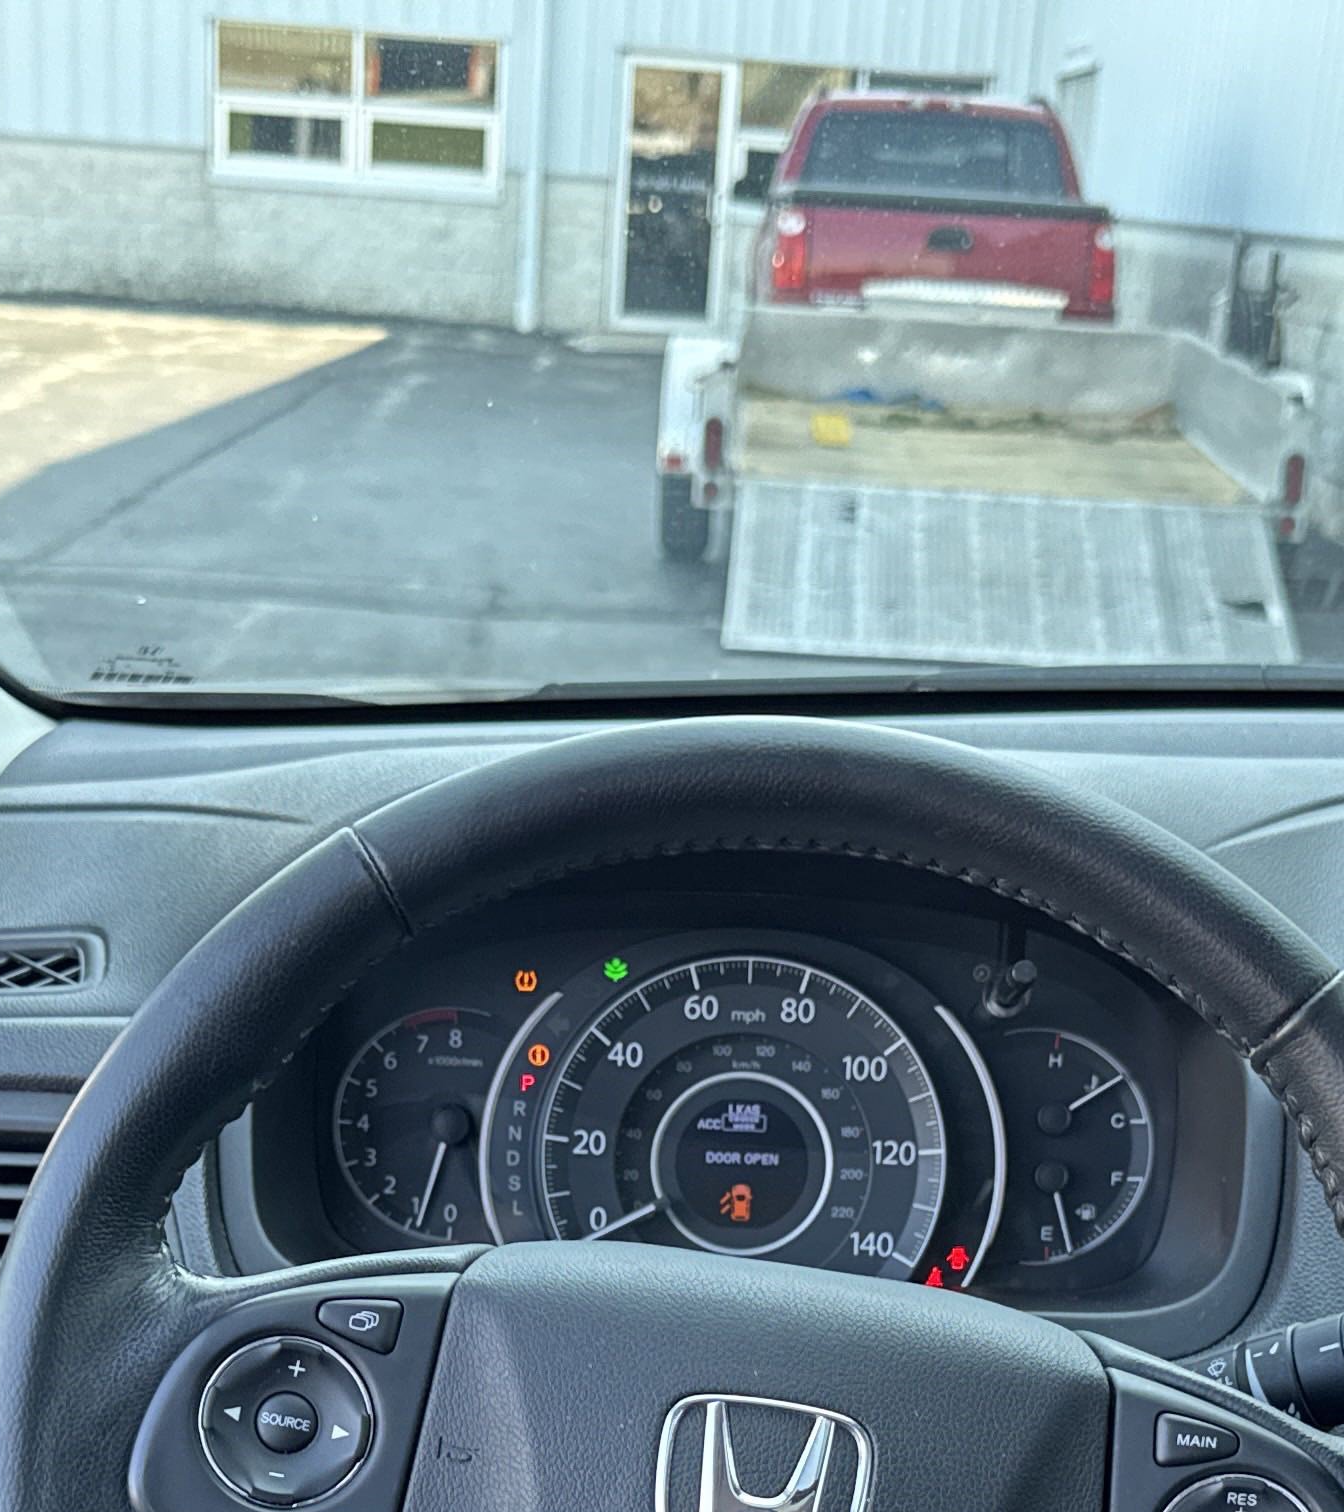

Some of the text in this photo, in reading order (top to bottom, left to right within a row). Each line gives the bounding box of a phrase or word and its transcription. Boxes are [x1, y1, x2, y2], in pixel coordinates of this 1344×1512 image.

[684, 996, 718, 1020] 60
[731, 1009, 766, 1023] mph
[781, 999, 815, 1023] 80
[416, 1036, 429, 1053] 7
[449, 1031, 462, 1048] 8
[384, 1052, 397, 1070] 6
[608, 1042, 642, 1067] 40
[1049, 1054, 1062, 1068] H
[842, 1057, 887, 1081] 100
[365, 1080, 378, 1097] 5
[520, 1075, 535, 1090] P
[514, 1101, 526, 1116] R
[357, 1114, 370, 1131] 4
[1110, 1114, 1125, 1129] C
[509, 1127, 522, 1140] N
[573, 1131, 606, 1155] 20
[364, 1149, 376, 1166] 3
[507, 1151, 520, 1165] D
[706, 1152, 779, 1165] DOOR OPEN
[873, 1141, 916, 1165] 120
[384, 1177, 396, 1193] 2
[509, 1176, 521, 1191] S
[1111, 1173, 1123, 1186] F
[413, 1197, 419, 1213] 1
[444, 1205, 457, 1221] 0
[513, 1201, 523, 1216] L
[590, 1207, 606, 1231] 0
[1041, 1227, 1053, 1241] E
[850, 1233, 893, 1257] 140
[260, 1412, 311, 1432] SOURCE
[1176, 1434, 1218, 1449] MAIN
[1227, 1492, 1258, 1507] RES
